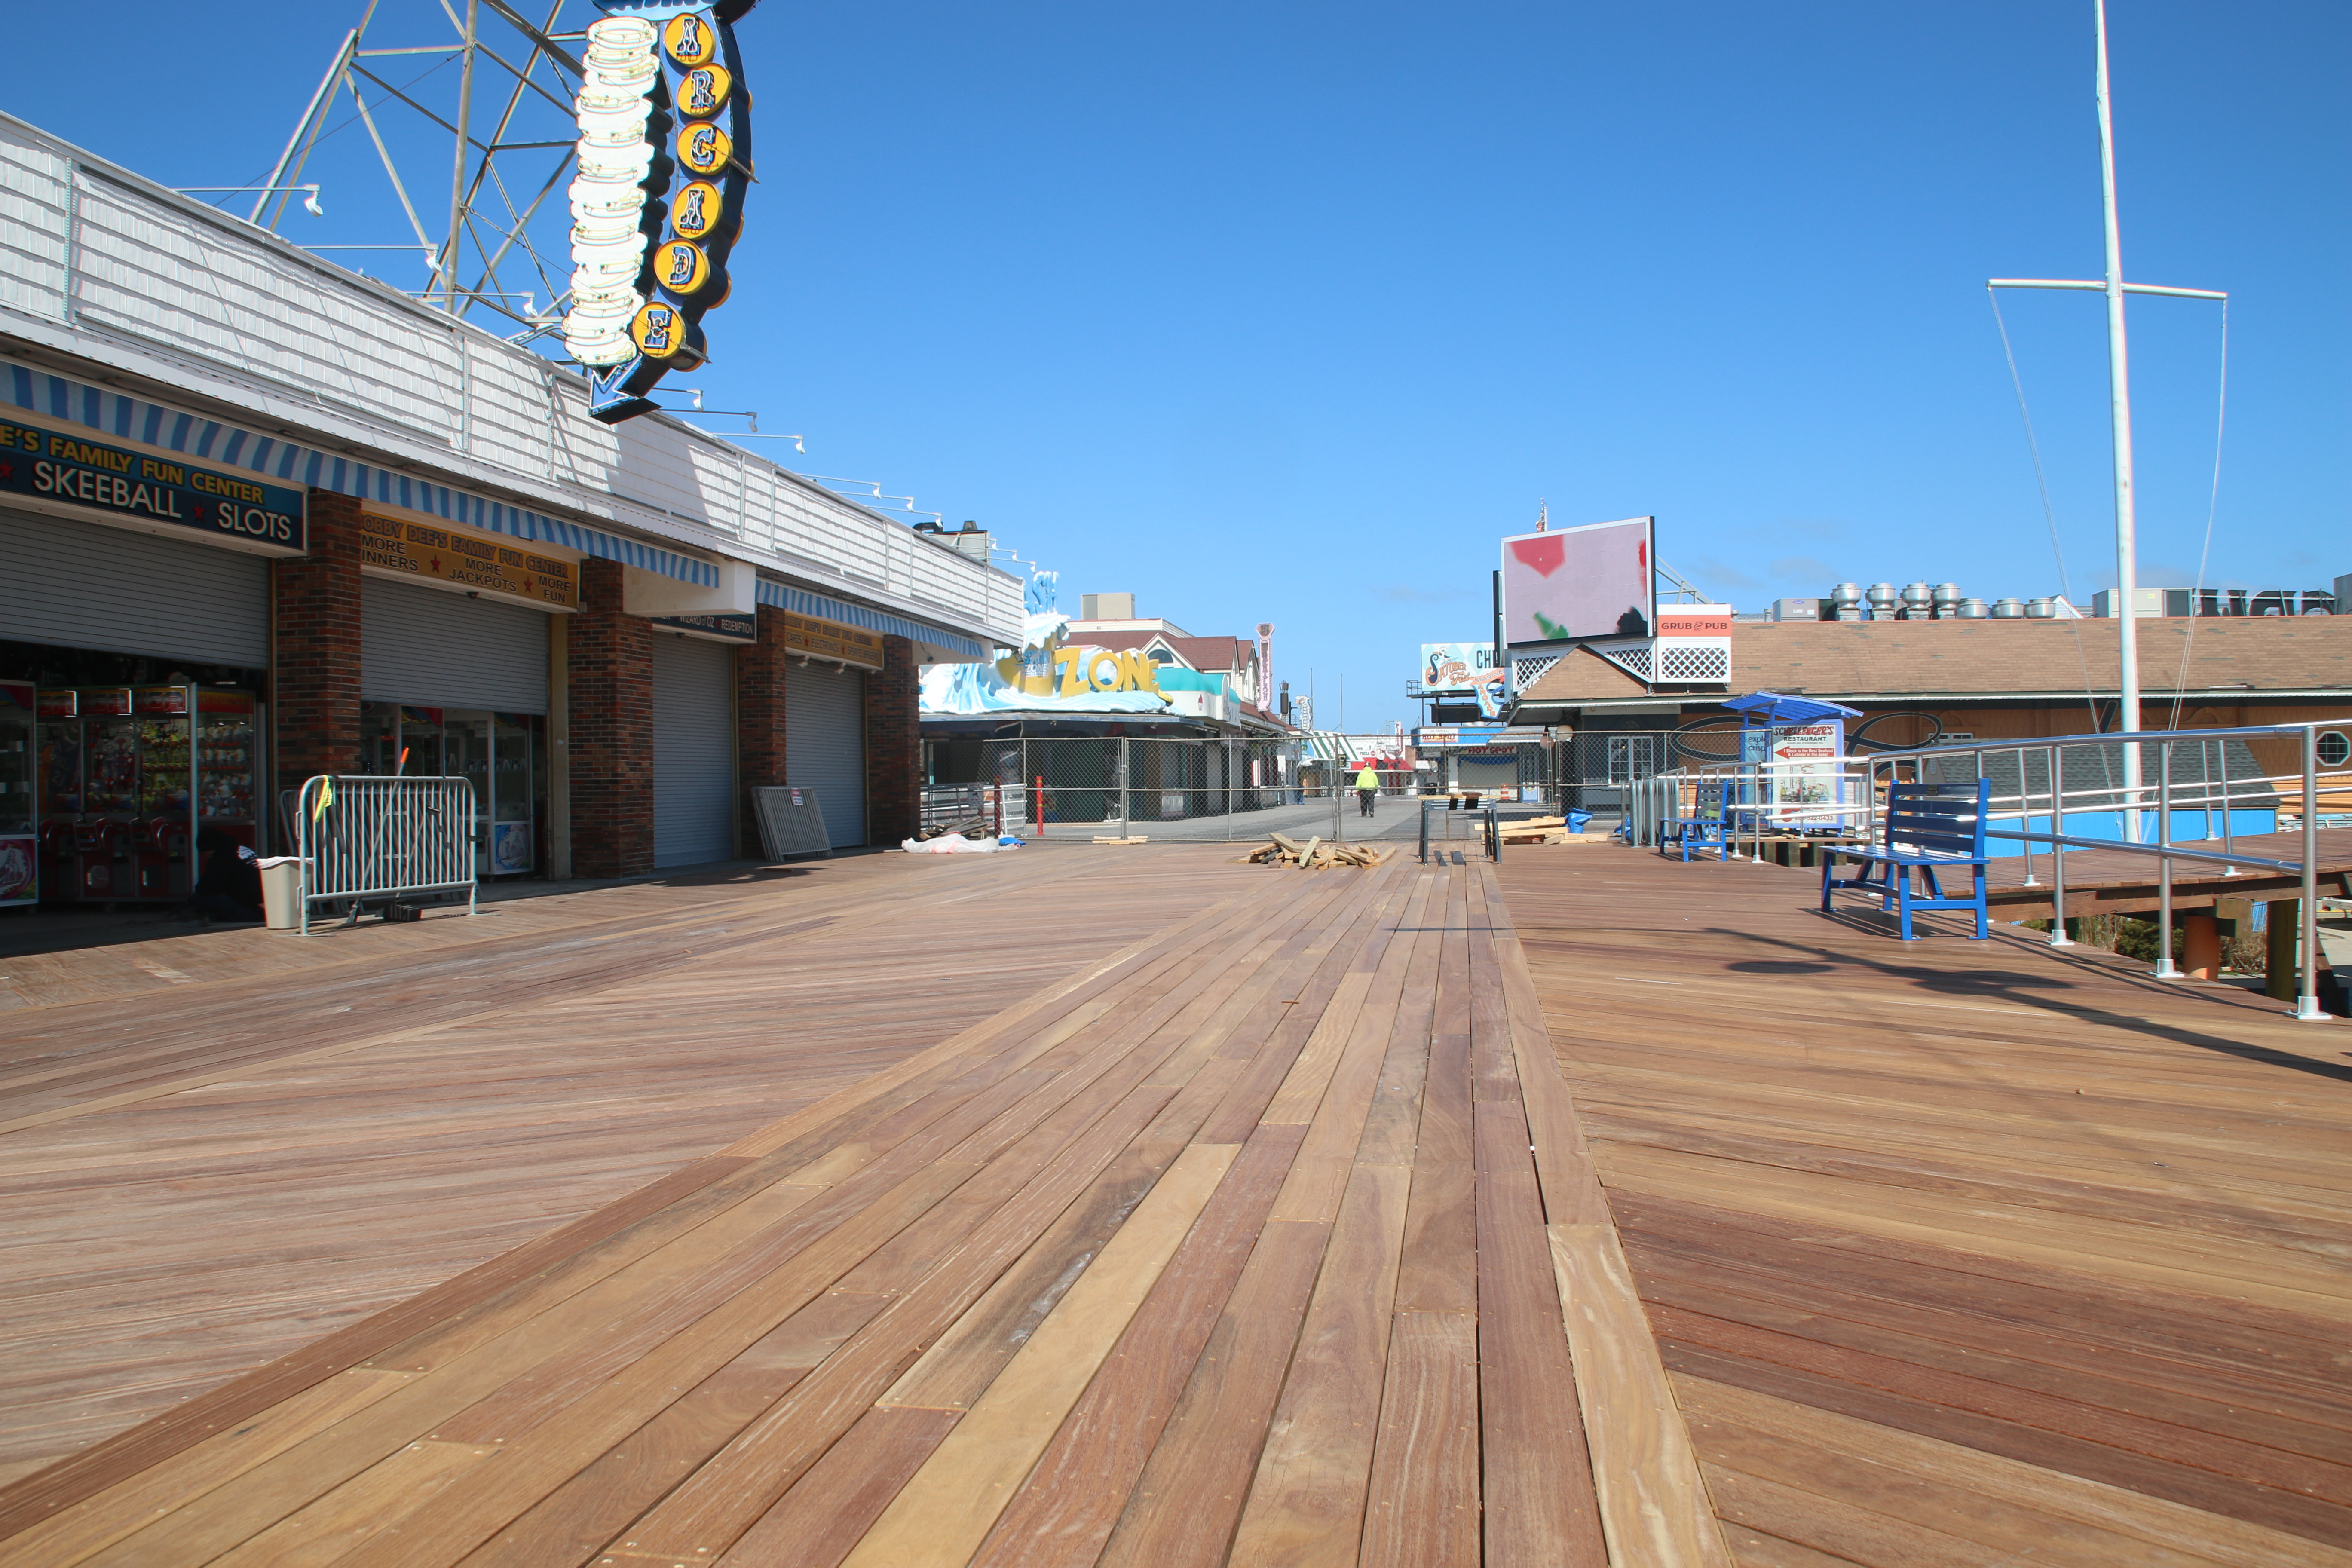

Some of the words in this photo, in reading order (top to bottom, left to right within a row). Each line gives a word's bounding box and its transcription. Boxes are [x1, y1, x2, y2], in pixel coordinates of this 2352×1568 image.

[643, 17, 715, 347] ARCADE
[49, 435, 135, 475] FAMILY
[141, 458, 184, 487] FUN
[190, 471, 265, 506] CENTER
[33, 461, 182, 519] SKEEBALL
[217, 502, 291, 541] SLOTS
[360, 514, 404, 539] OBBY
[408, 525, 448, 548] DEE'S
[451, 536, 497, 560] FAMILY
[499, 548, 523, 567] FUN
[526, 556, 568, 579] CENTER
[362, 533, 406, 556] MORE
[361, 549, 419, 572] INNERS
[466, 557, 502, 576] MORE
[449, 568, 517, 592] JACKPOTS
[539, 576, 571, 592] MORE
[543, 589, 566, 603] FUN
[680, 616, 701, 626] WIZARD
[701, 616, 707, 626] of
[707, 616, 714, 628] OZ
[721, 619, 753, 634] REDEMPTION
[823, 624, 841, 638] FAMILY
[842, 629, 853, 642] FUN
[854, 632, 873, 646] CENTER
[1694, 621, 1703, 632] &
[812, 637, 839, 652] ELECTRONICS
[848, 646, 862, 658] SPORTS
[863, 649, 879, 662] JERSEYS
[1476, 650, 1495, 669] CH
[1054, 647, 1159, 700] ZONE
[1474, 668, 1505, 683] MARINE
[1477, 684, 1496, 717] ARCADE
[1773, 726, 1834, 736] SCHELLENGER'S
